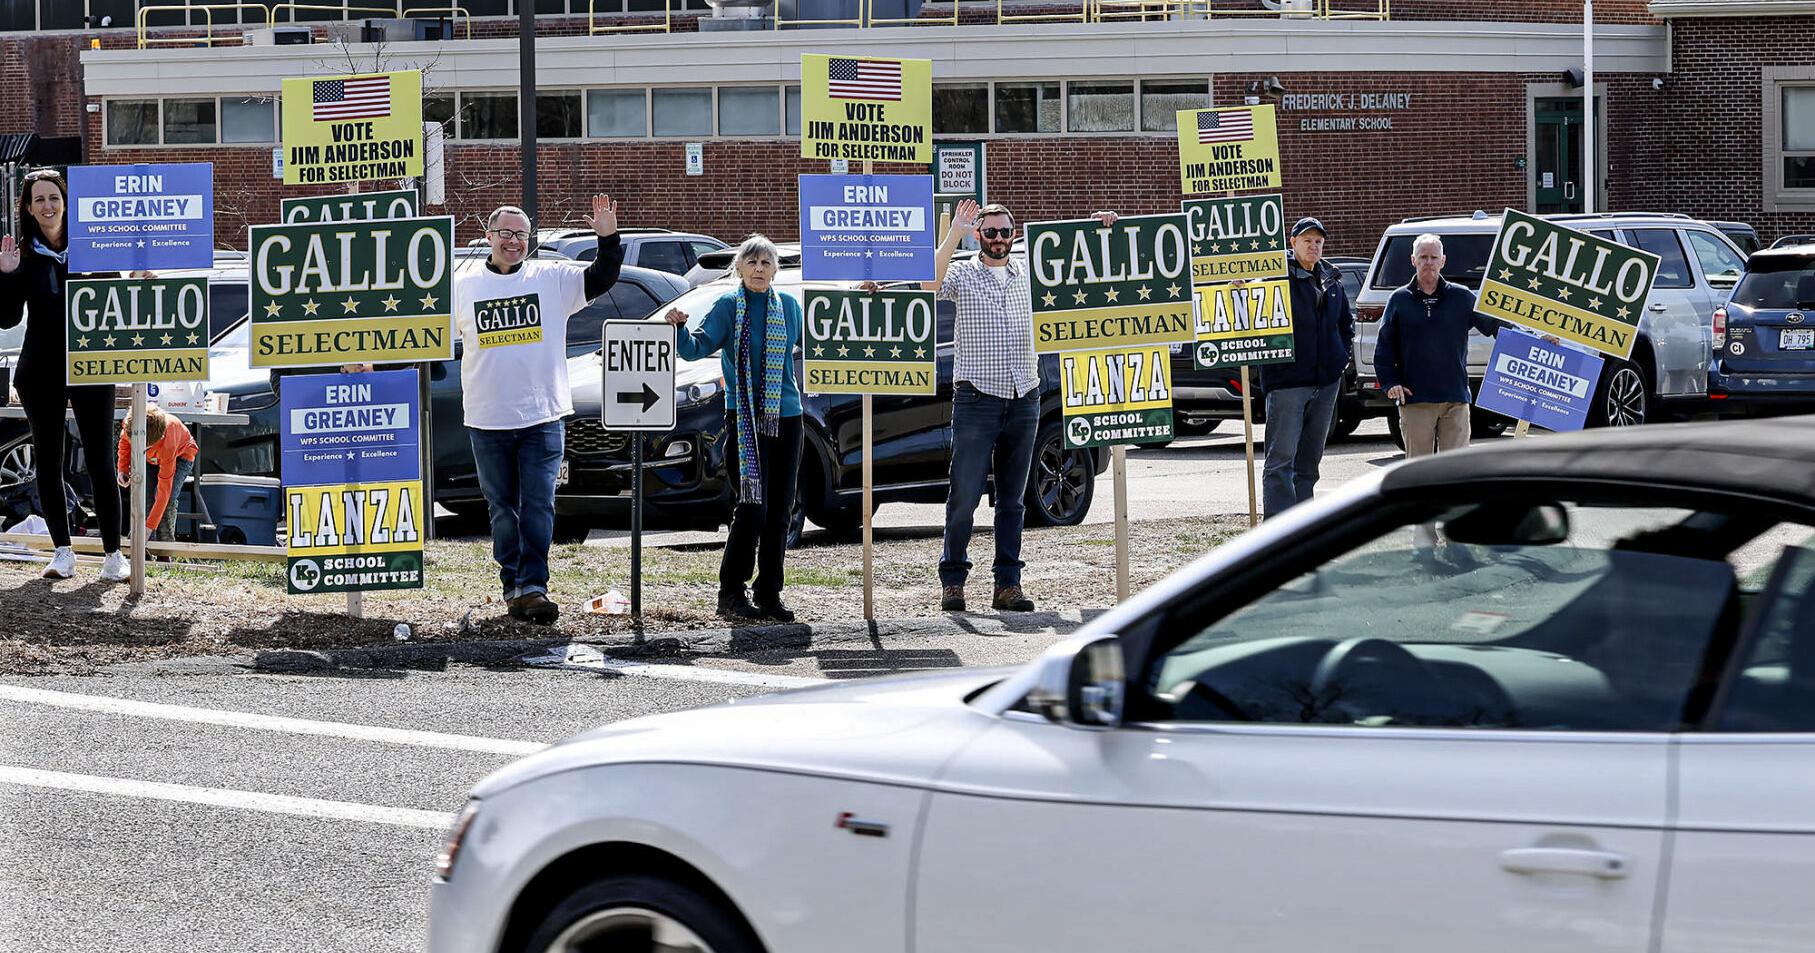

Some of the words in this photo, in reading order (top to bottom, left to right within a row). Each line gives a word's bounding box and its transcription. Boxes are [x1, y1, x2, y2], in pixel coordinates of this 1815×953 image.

[1282, 94, 1342, 110] FREDERICK
[1348, 94, 1356, 109] J.
[1361, 93, 1411, 109] DELANEY
[845, 103, 884, 122] VOTE
[331, 122, 373, 142] VOTE
[808, 121, 834, 140] JIM
[838, 124, 923, 144] ANDERSON
[1301, 118, 1356, 131] ELEMENTARY
[1359, 117, 1393, 129] SCHOOL
[291, 146, 319, 165] JIM
[324, 139, 414, 164] ANDERSON
[815, 142, 839, 158] FOR
[842, 144, 916, 161] SELECTMAN
[1212, 145, 1242, 160] VOTE
[300, 167, 325, 182] FOR
[329, 161, 406, 181] SELECTMAN
[1186, 163, 1205, 178] JIM
[1209, 158, 1274, 177] ANDERSON
[115, 175, 163, 193] ERIN
[1192, 180, 1210, 192] FOR
[1212, 175, 1269, 190] SELECTMAN
[844, 186, 888, 203] ERIN
[92, 199, 188, 218] GREANEY
[823, 209, 912, 227] GREANEY
[108, 224, 140, 232] SCHOOL
[1187, 200, 1280, 241] GALLO
[92, 241, 132, 250] Experience
[823, 250, 861, 259] Experience
[1033, 223, 1185, 287] GALLO
[256, 227, 446, 296] GALLO
[1193, 258, 1282, 276] SELECTMAN
[1500, 220, 1649, 303] GALLO
[71, 283, 205, 332] GALLO
[477, 303, 539, 331] GALLO
[1194, 286, 1290, 334] LANZA
[807, 296, 932, 343] GALLO
[1039, 313, 1188, 342] SELECTMAN
[1484, 290, 1628, 349] SELECTMAN
[258, 327, 443, 356] SELECTMAN
[479, 331, 540, 346] SELECTMAN
[1221, 339, 1266, 350] SCHOOL
[1798, 335, 1811, 344] 795
[608, 340, 671, 372] ENTER
[1222, 349, 1292, 362] COMMITTEE
[1528, 346, 1565, 369] ERIN
[73, 357, 204, 376] SELECTMAN
[1507, 360, 1578, 392] GREANEY
[810, 369, 929, 386] SELECTMAN
[1064, 351, 1169, 407] LANZA
[326, 383, 371, 405] ERIN
[1500, 376, 1513, 385] WPS
[1514, 380, 1537, 392] SCHOOL
[1538, 389, 1571, 403] COMMITTEE
[1499, 388, 1528, 402] Experience
[1542, 402, 1569, 415] Excellence
[304, 407, 396, 430] GREANEY
[1094, 413, 1143, 426] SCHOOL
[300, 437, 317, 445] WPS
[319, 435, 350, 444] SCHOOL
[352, 433, 395, 442] COMMITTEE
[1094, 425, 1171, 440] COMMITTEE
[304, 452, 343, 461] Experience
[361, 450, 397, 458] Excellence
[289, 488, 418, 548] LANZA
[324, 557, 385, 570] SCHOOL
[324, 570, 419, 586] COMMITTEE
